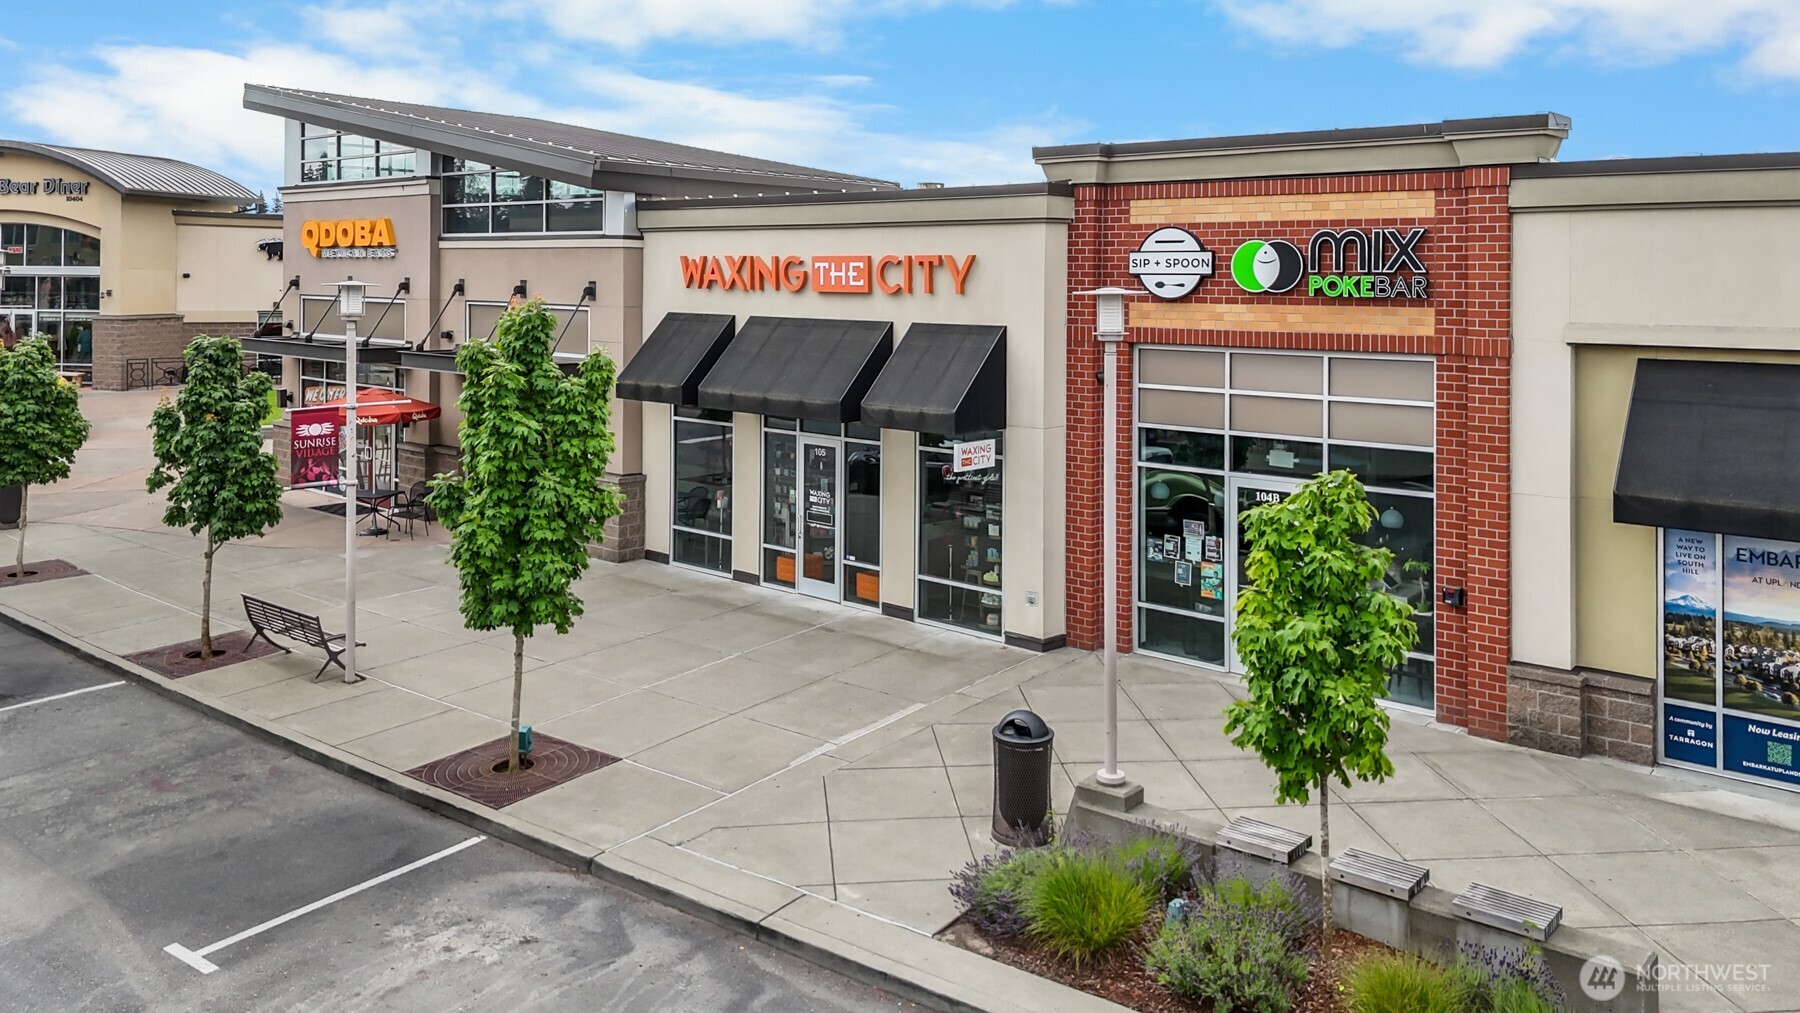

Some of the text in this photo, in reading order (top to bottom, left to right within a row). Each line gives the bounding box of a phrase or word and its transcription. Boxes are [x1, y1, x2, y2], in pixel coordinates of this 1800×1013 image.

[0, 178, 90, 195] Bear Diner
[301, 218, 396, 257] QDOBA
[1308, 228, 1427, 273] MIX
[1131, 258, 1150, 268] SIP
[1165, 258, 1210, 269] SPOON
[680, 254, 976, 294] WAXING THE CITY
[305, 389, 319, 402] WE
[294, 436, 336, 449] SUNRISE
[296, 447, 335, 458] VILLAGE
[814, 448, 826, 456] 105
[961, 444, 992, 456] WAXING
[962, 454, 992, 466] THE CITY
[809, 489, 830, 498] WAXING
[1255, 491, 1280, 503] 104B
[1685, 537, 1703, 545] NEW
[1675, 551, 1692, 559] LIVE
[1677, 559, 1704, 568] SOUTH
[1682, 567, 1699, 575] HILL
[1752, 576, 1763, 584] AT
[1674, 717, 1705, 728] community
[1705, 722, 1713, 730] by
[1748, 723, 1771, 736] Now
[1668, 733, 1714, 749] TARRAGON
